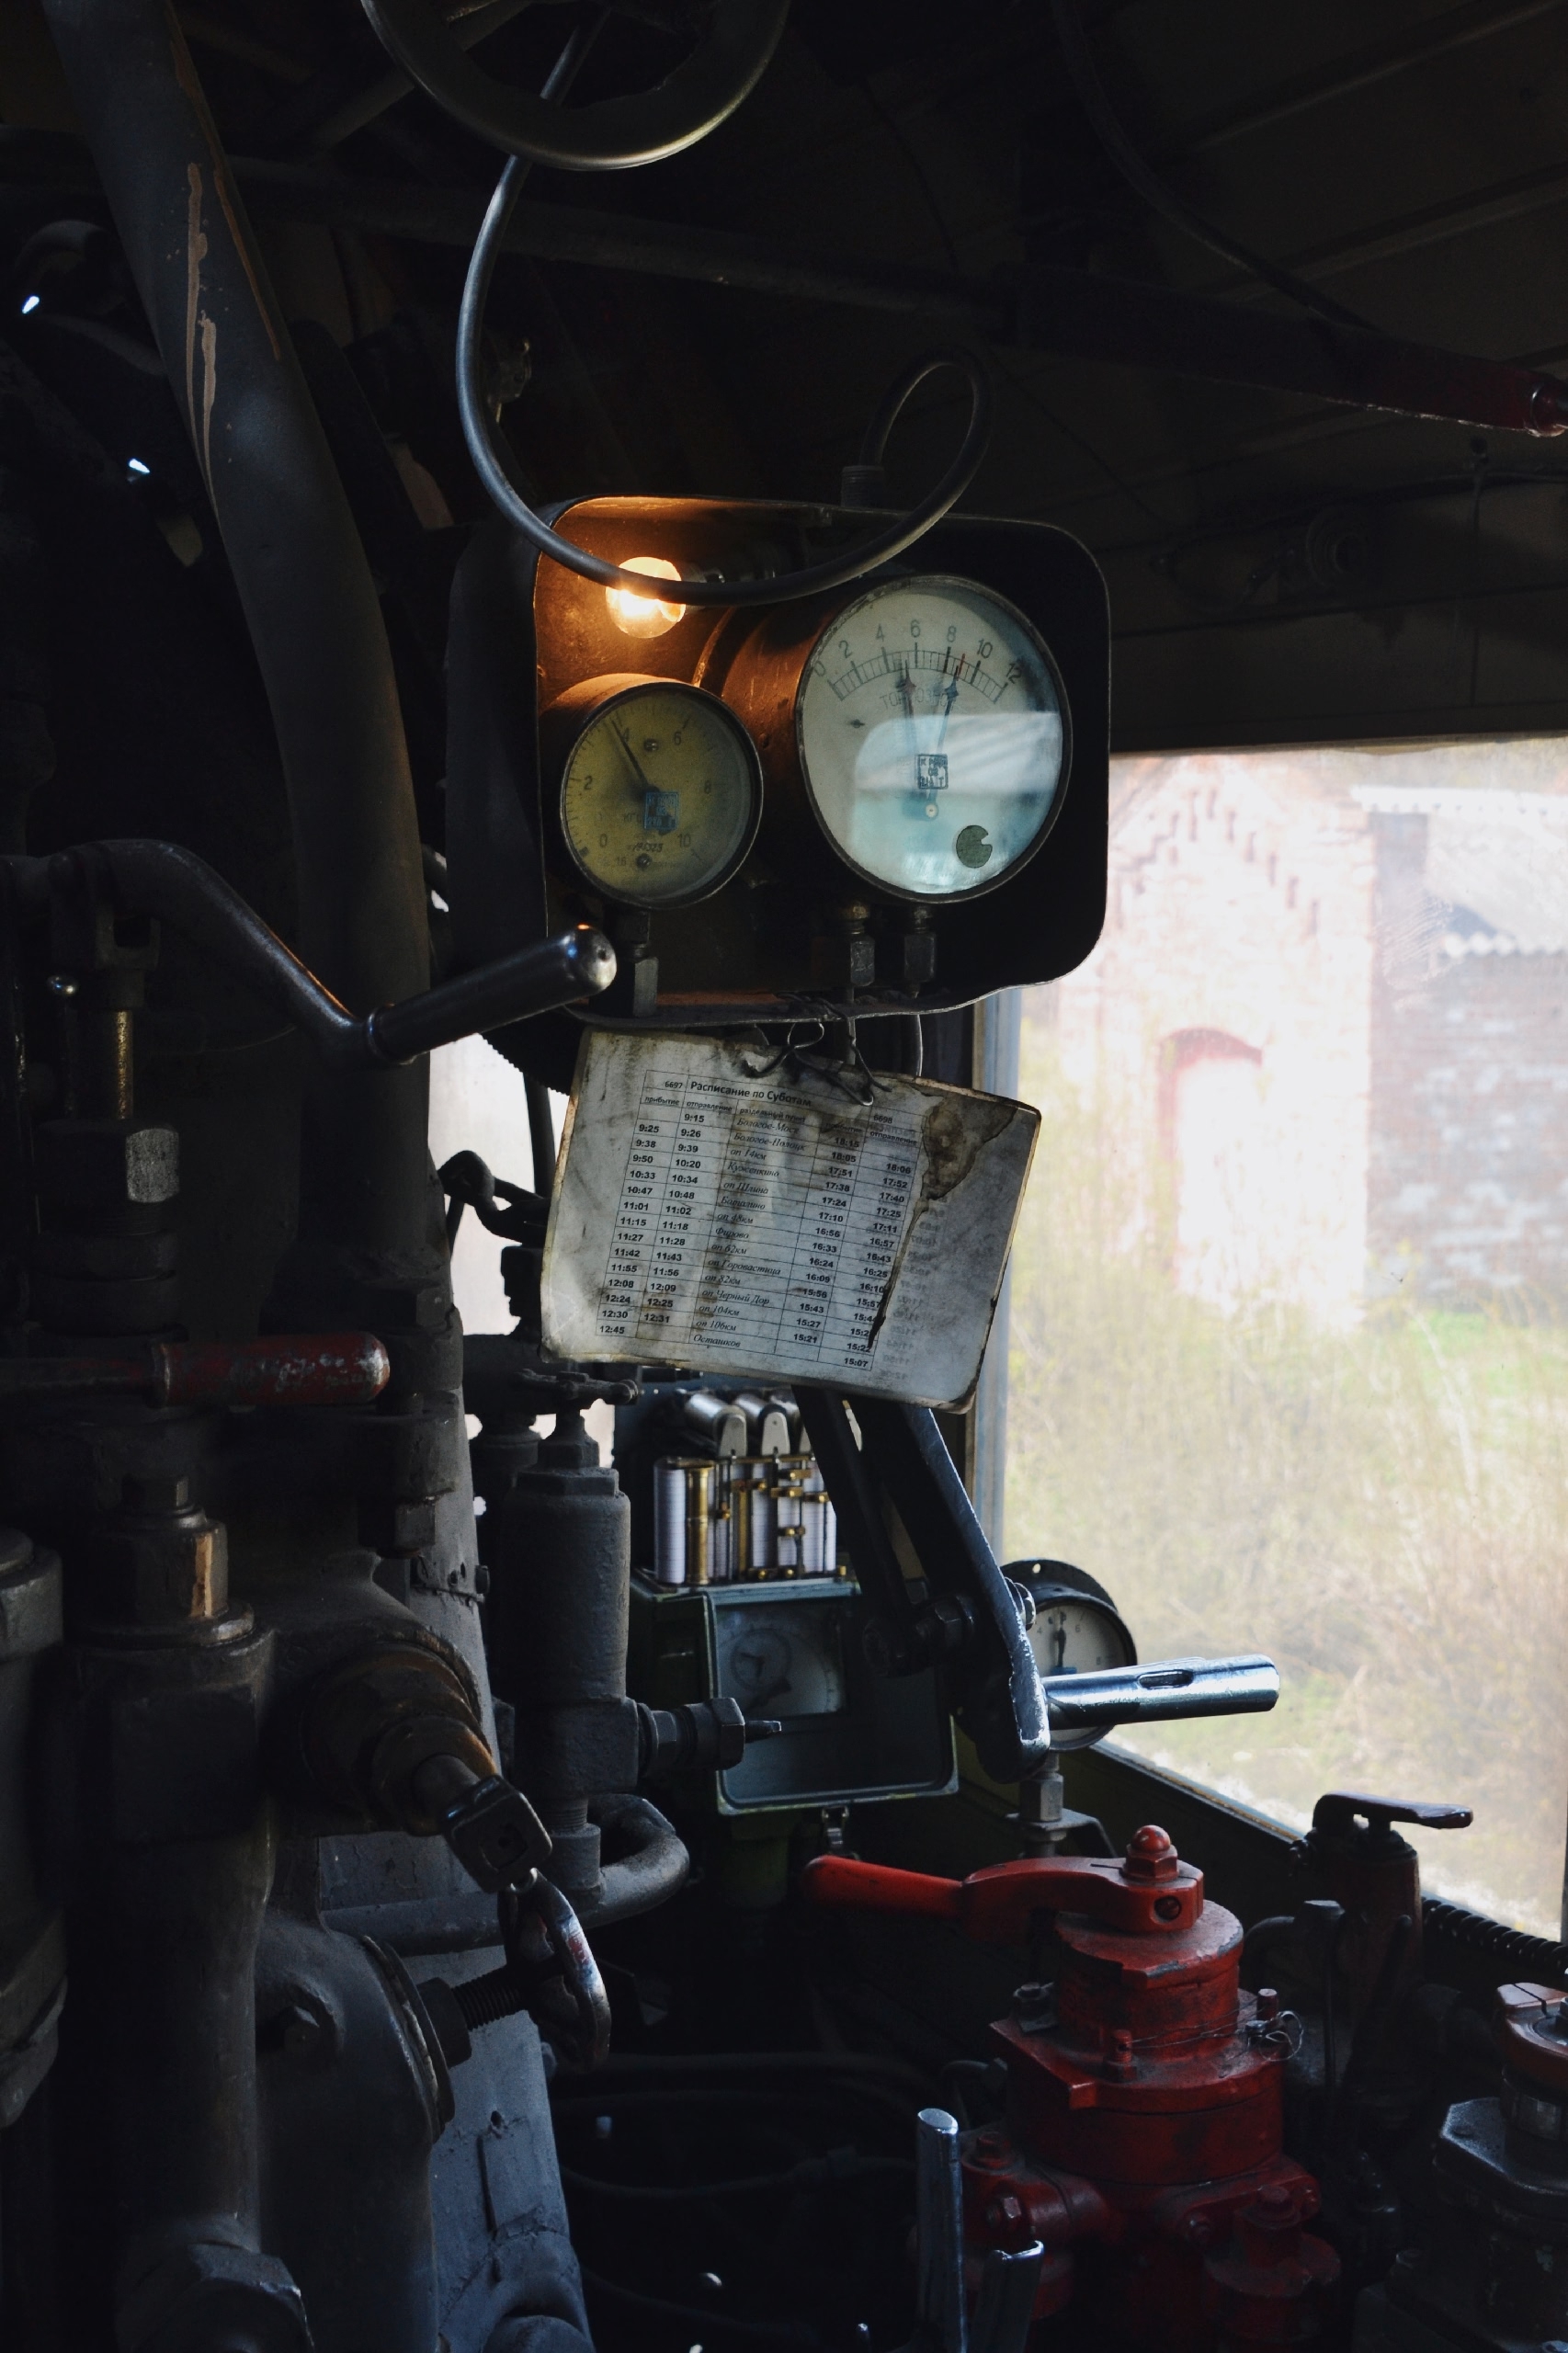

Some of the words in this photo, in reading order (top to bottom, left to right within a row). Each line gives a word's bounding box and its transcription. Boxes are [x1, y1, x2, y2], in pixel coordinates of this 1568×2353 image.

[875, 623, 885, 642] 4
[910, 620, 920, 638] 6
[947, 625, 957, 643] 8
[838, 640, 853, 658] 2
[978, 638, 994, 658] 10
[1006, 662, 1022, 684] 12
[674, 732, 682, 746] 6
[584, 776, 593, 790] 2
[600, 833, 608, 847] 0
[678, 834, 691, 848] 10
[665, 1081, 683, 1089] 6697
[690, 1081, 750, 1097] Расписание
[752, 1089, 765, 1098] по
[767, 1090, 812, 1107] Суботам
[873, 1114, 893, 1123] 6698
[645, 1097, 680, 1106] прибытие
[687, 1101, 733, 1112] отправление
[869, 1131, 917, 1145] отправление
[684, 1114, 704, 1123] 9:15
[835, 1137, 859, 1148] 18:15
[636, 1140, 656, 1148] 9:38
[678, 1143, 699, 1153] 9:39
[829, 1166, 853, 1177] 17:51
[883, 1178, 908, 1188] 17:52
[639, 1123, 660, 1133] 9:25
[681, 1129, 701, 1138] 9:26
[832, 1152, 857, 1163] 18:05
[886, 1163, 911, 1175] 18:06
[630, 1170, 655, 1180] 10:33
[672, 1175, 699, 1184] 10:34
[823, 1197, 846, 1208] 17:24
[877, 1208, 902, 1218] 17:25
[632, 1154, 653, 1164] 9:50
[676, 1159, 700, 1169] 10:20
[825, 1182, 850, 1192] 17:38
[880, 1192, 904, 1203] 17:40
[624, 1202, 649, 1211] 11:01
[666, 1206, 691, 1215] 11:02
[815, 1228, 840, 1238] 16:56
[870, 1237, 894, 1248] 16:57
[627, 1187, 653, 1195] 10:47
[669, 1191, 695, 1199] 10:48
[819, 1212, 844, 1222] 17:10
[873, 1223, 898, 1233] 17:11
[618, 1233, 643, 1242] 11:27
[660, 1237, 686, 1246] 11:28
[810, 1257, 834, 1267] 16:24
[863, 1267, 888, 1279] 16:25
[620, 1217, 647, 1226] 11:15
[663, 1222, 688, 1230] 11:18
[715, 1227, 749, 1239] Фирово
[812, 1243, 837, 1253] 16:33
[867, 1253, 892, 1263] 16:43
[611, 1265, 637, 1273] 11:55
[653, 1267, 679, 1277] 11:56
[802, 1289, 827, 1299] 15:56
[615, 1248, 641, 1257] 11:42
[656, 1252, 682, 1261] 11:43
[806, 1273, 831, 1283] 16:09
[608, 1279, 634, 1289] 12:08
[651, 1283, 676, 1292] 12:09
[800, 1303, 824, 1313] 15:43
[602, 1311, 629, 1319] 12:30
[644, 1313, 670, 1323] 12:31
[794, 1334, 818, 1344] 15:21
[606, 1294, 631, 1304] 12:24
[648, 1298, 673, 1308] 12:25
[796, 1318, 821, 1328] 15:27
[851, 1328, 869, 1337] 15:2
[599, 1325, 625, 1335] 12:45
[693, 1335, 741, 1347] Осташков
[844, 1358, 869, 1368] 15:07
